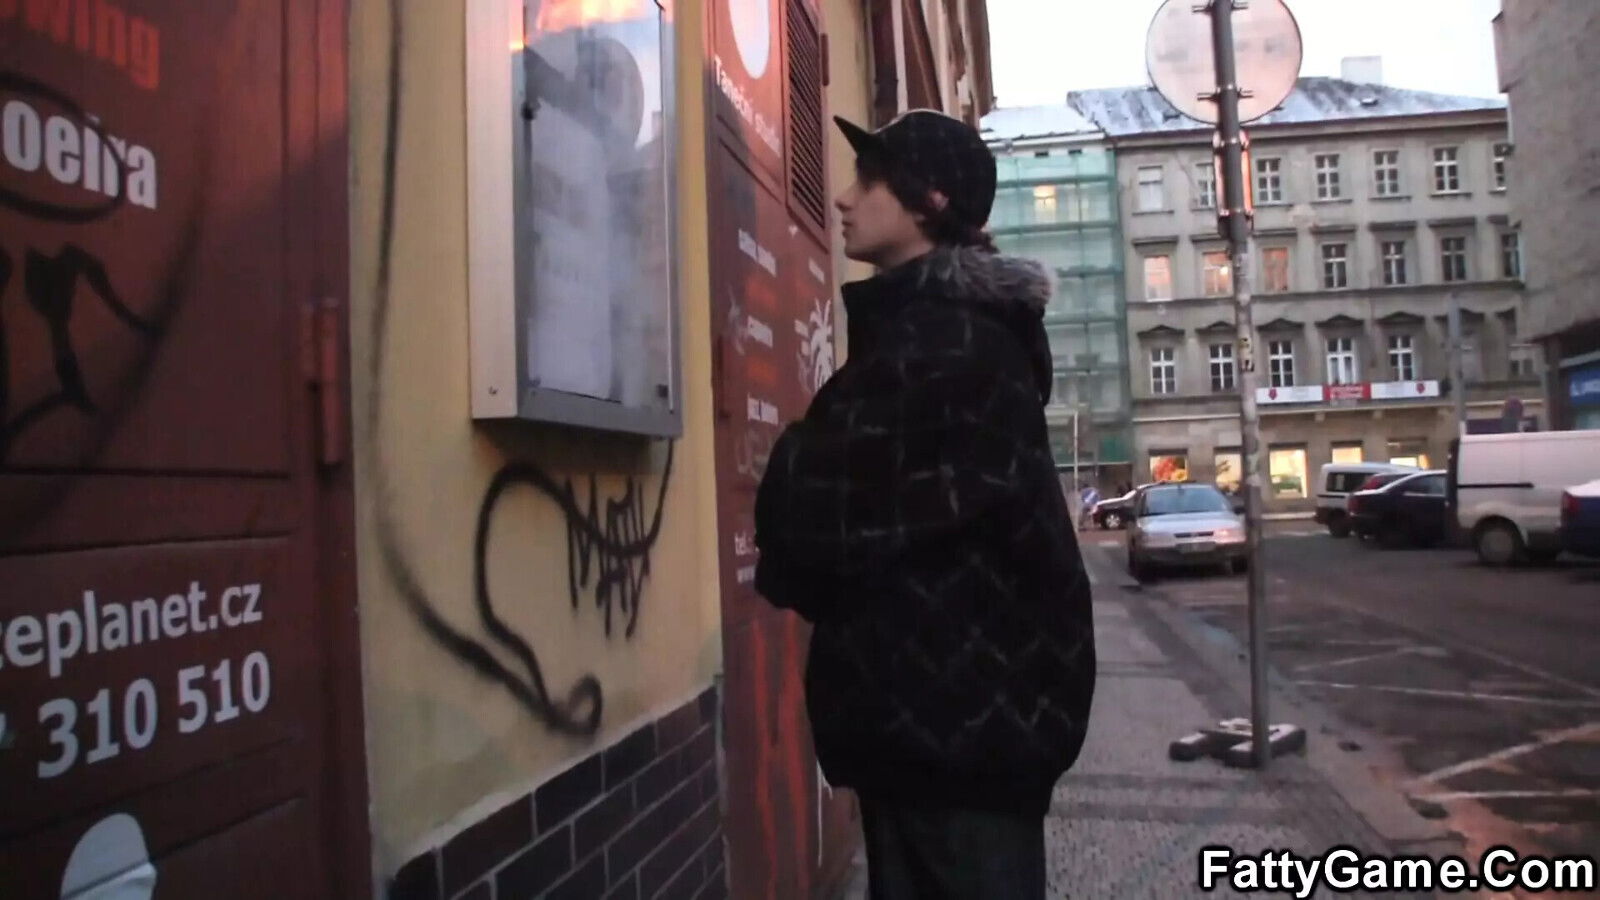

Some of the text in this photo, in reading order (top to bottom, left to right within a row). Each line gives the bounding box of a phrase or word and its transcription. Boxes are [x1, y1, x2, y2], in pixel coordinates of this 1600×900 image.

[0, 581, 263, 678] eplanet.cz
[37, 678, 158, 778] 310
[177, 651, 271, 733] 510
